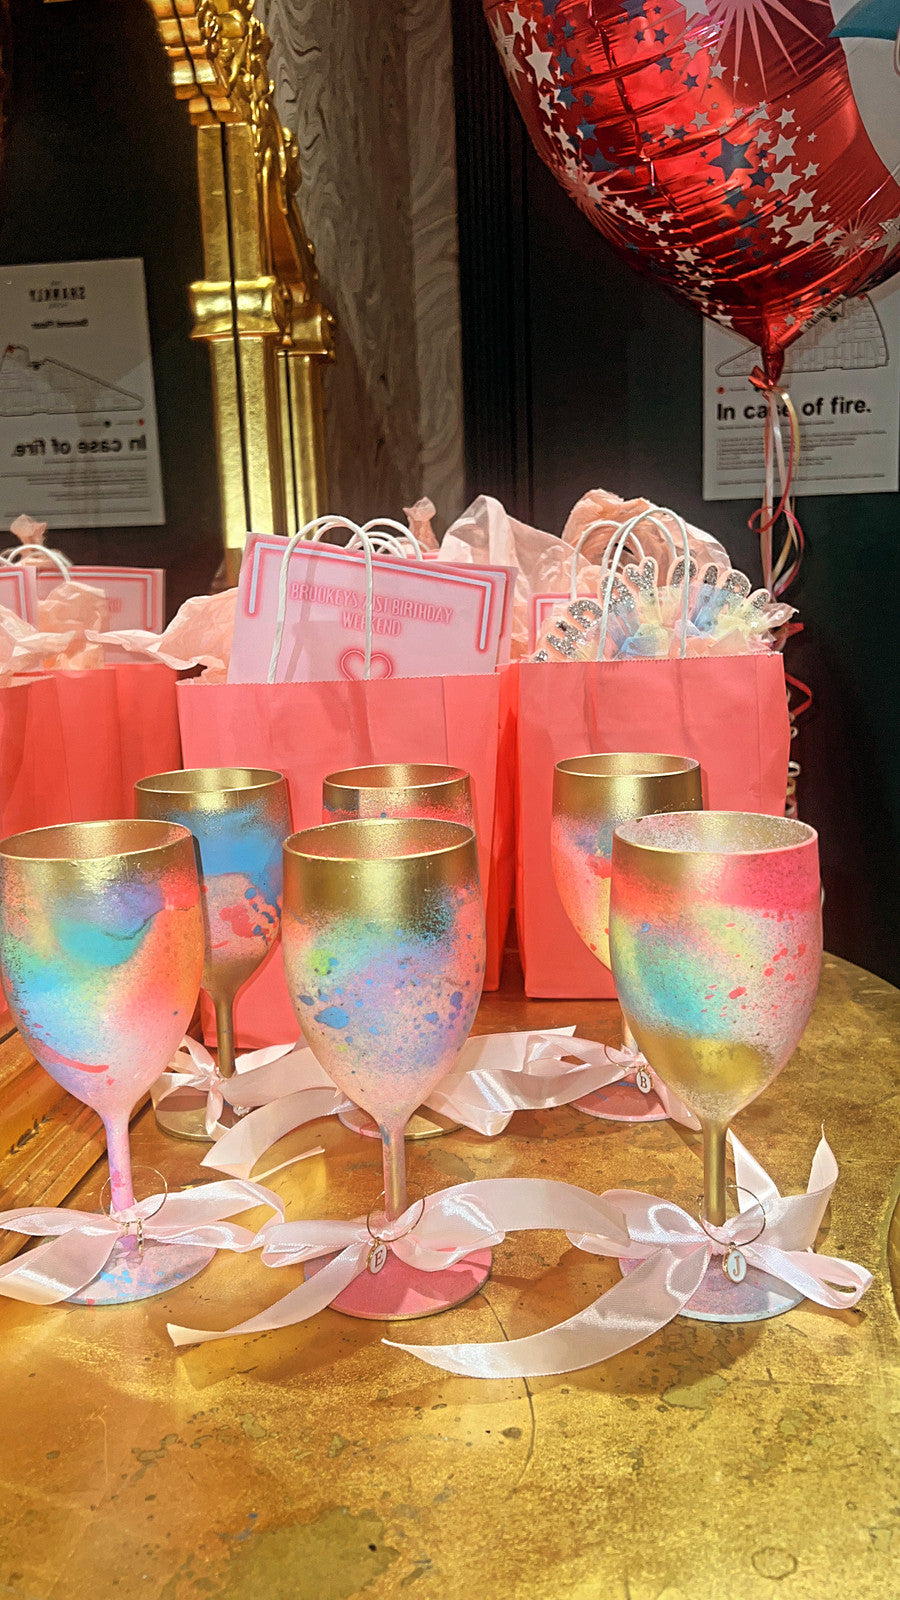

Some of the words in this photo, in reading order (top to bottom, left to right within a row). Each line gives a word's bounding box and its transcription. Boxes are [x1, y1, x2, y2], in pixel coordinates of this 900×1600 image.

[717, 403, 736, 420] In
[744, 403, 790, 420] cae
[802, 398, 824, 416] of
[831, 396, 872, 415] fire.
[392, 599, 454, 624] BIRTHDAY
[640, 1076, 648, 1088] B
[374, 1249, 384, 1268] E
[732, 1255, 741, 1278] J
